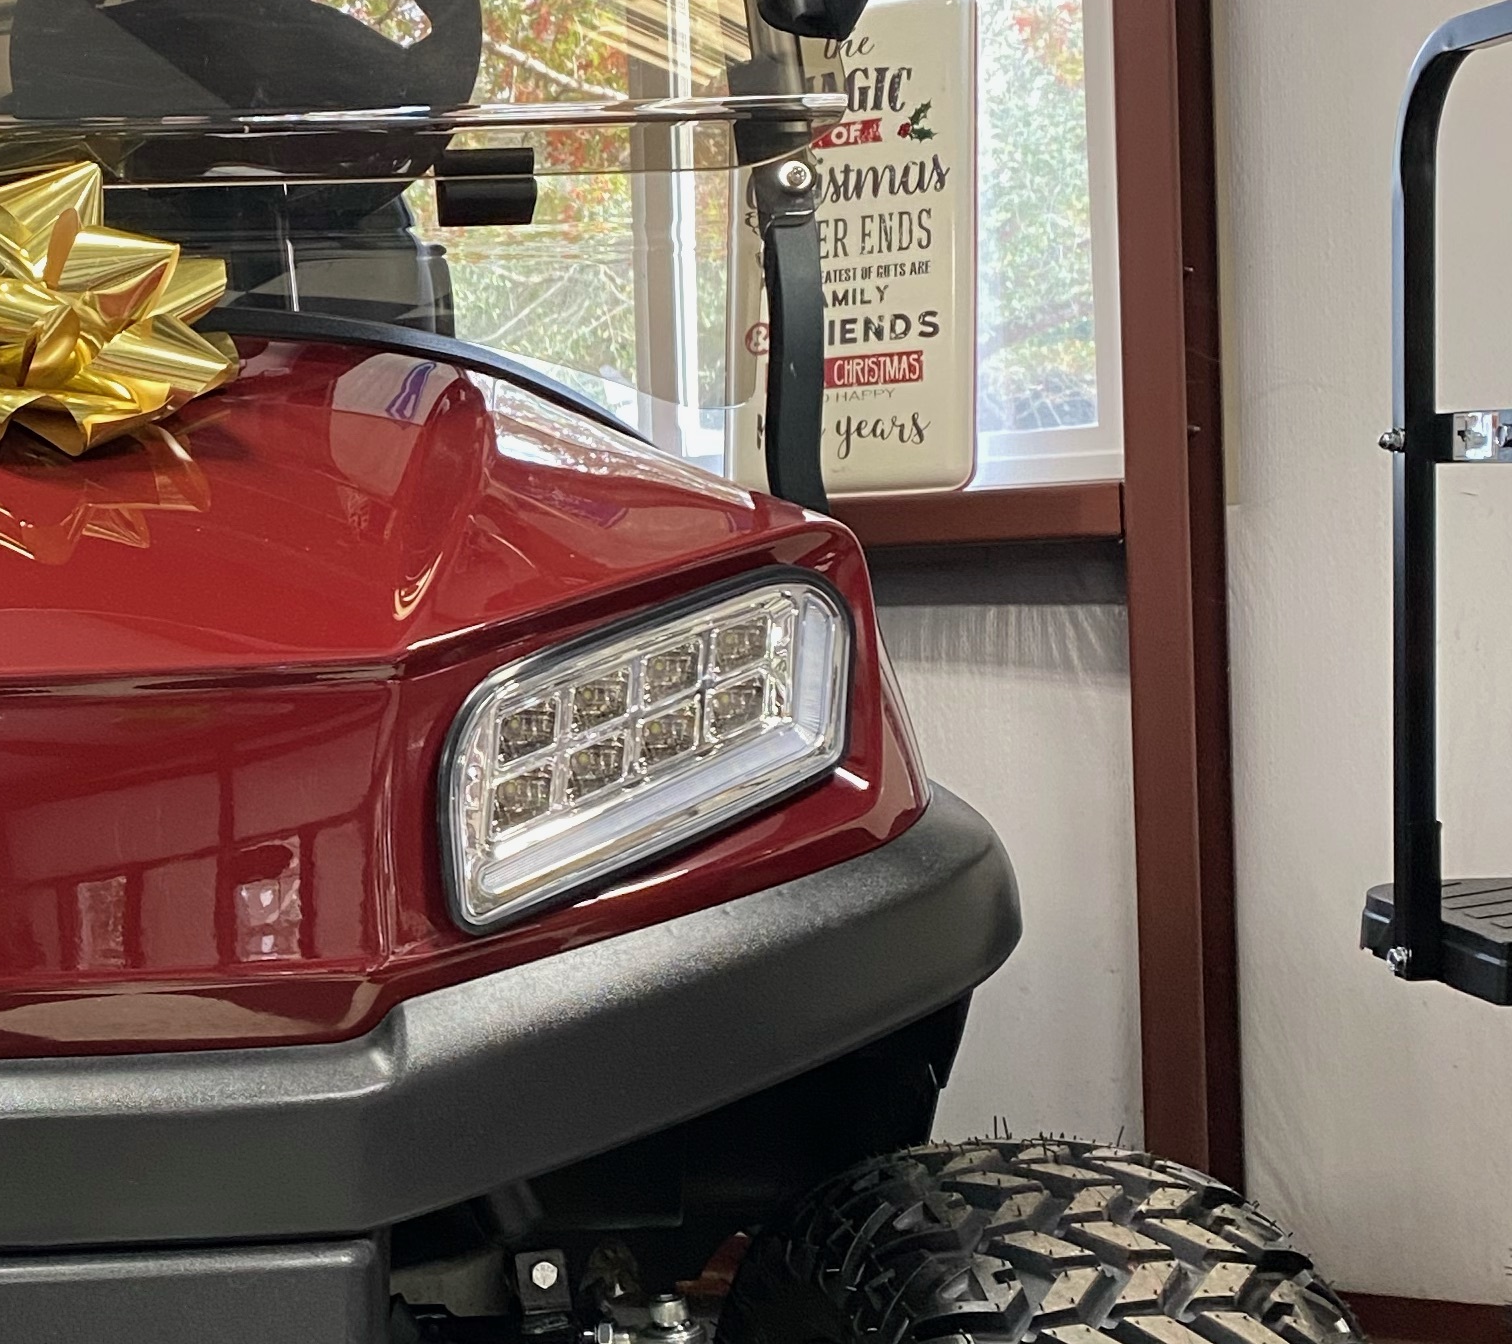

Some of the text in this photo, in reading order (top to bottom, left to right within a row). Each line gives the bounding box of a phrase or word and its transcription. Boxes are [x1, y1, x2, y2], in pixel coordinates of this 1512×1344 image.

[808, 67, 912, 113] AGIC
[831, 126, 861, 146] OF
[746, 154, 950, 209] istmas
[859, 208, 932, 255] ENDS
[861, 266, 873, 281] OF
[909, 260, 931, 275] ARE
[822, 285, 889, 308] MILY
[828, 310, 940, 346] IENDS
[833, 354, 920, 385] CHRISTMAS
[836, 388, 896, 403] HAPPY
[836, 412, 931, 459] years
